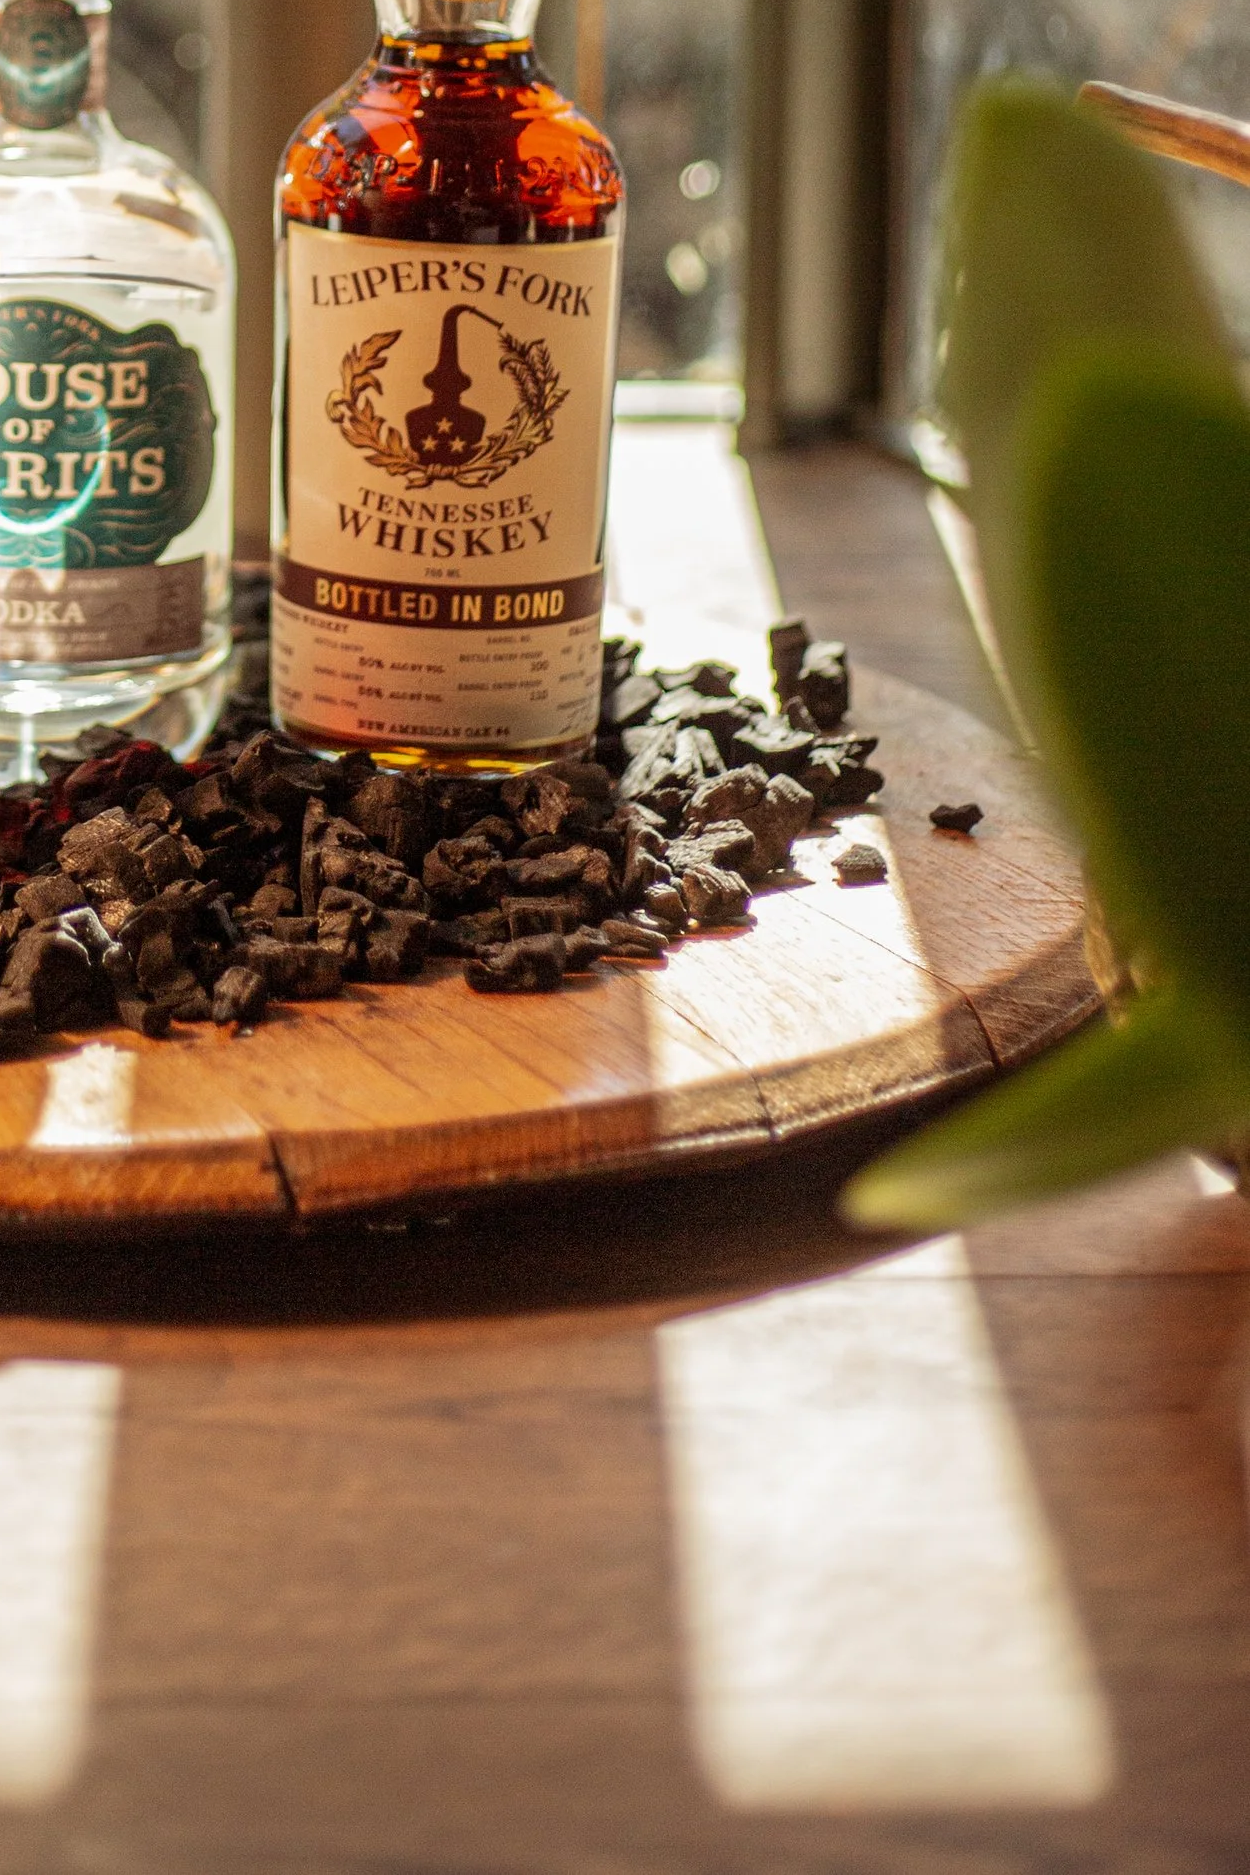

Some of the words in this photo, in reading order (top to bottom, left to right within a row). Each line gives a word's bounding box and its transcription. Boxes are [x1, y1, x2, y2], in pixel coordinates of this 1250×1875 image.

[311, 259, 486, 308] LEIPER'S
[494, 265, 596, 317] FORK
[2, 417, 55, 443] OF
[358, 487, 535, 524] TENNESSEE
[336, 503, 554, 559] WHISKEY
[314, 577, 439, 622] BOTTLED
[451, 594, 483, 623] IN
[494, 588, 566, 622] BOND
